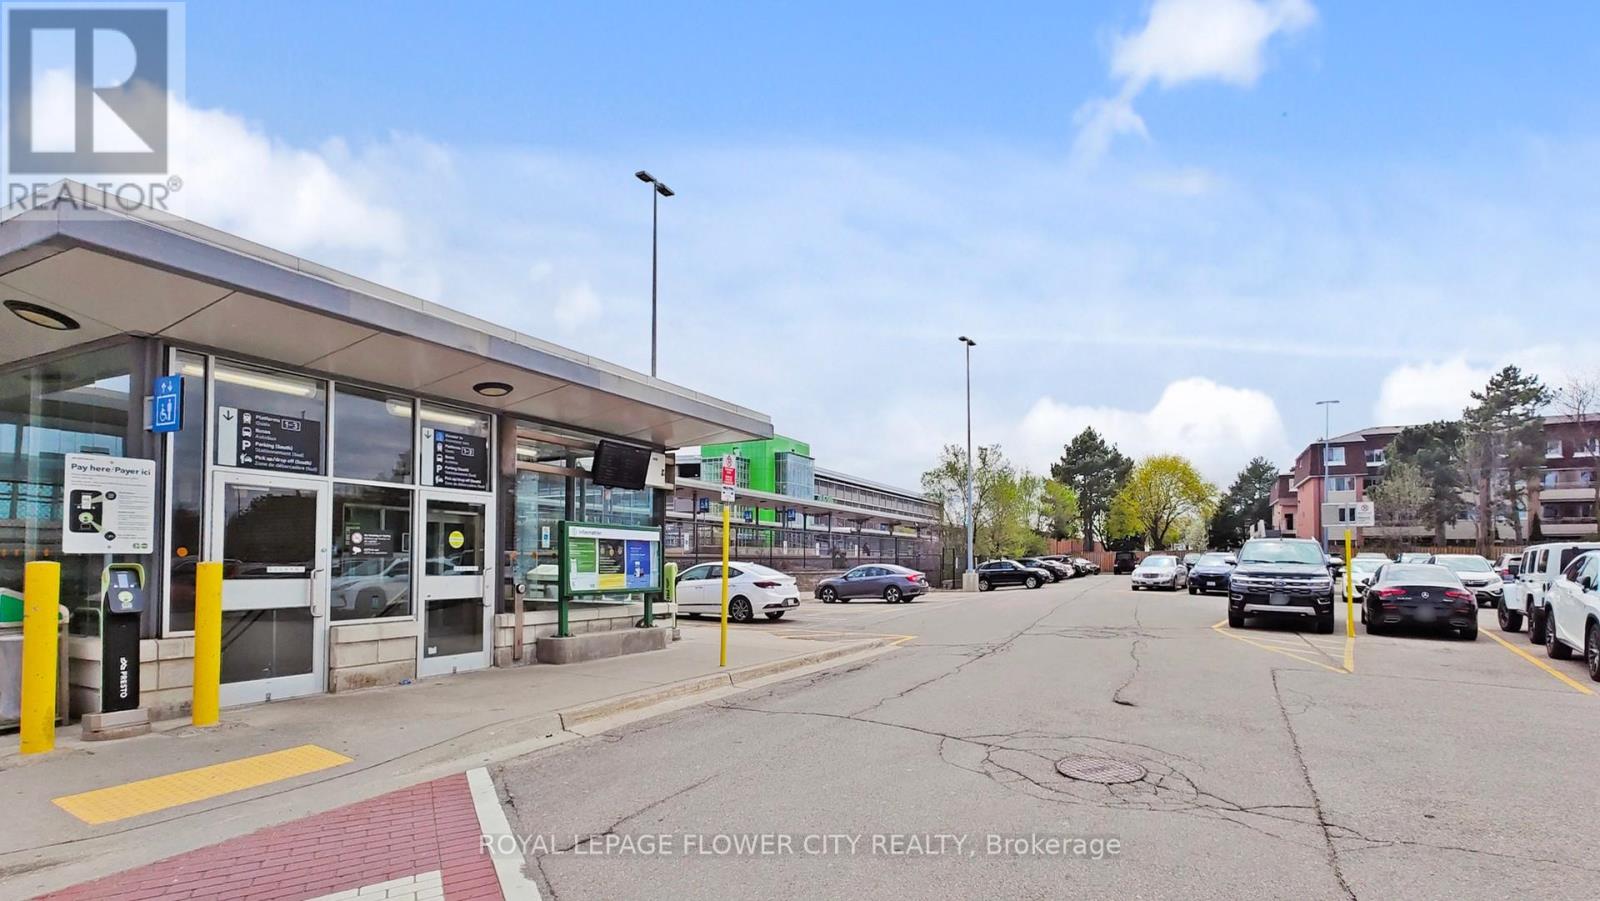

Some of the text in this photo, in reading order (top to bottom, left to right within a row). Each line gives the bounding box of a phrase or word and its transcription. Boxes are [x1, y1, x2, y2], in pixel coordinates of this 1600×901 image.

[71, 463, 88, 472] Pay
[90, 464, 111, 473] here
[115, 466, 139, 476] Payer
[120, 671, 128, 699] PRESTO
